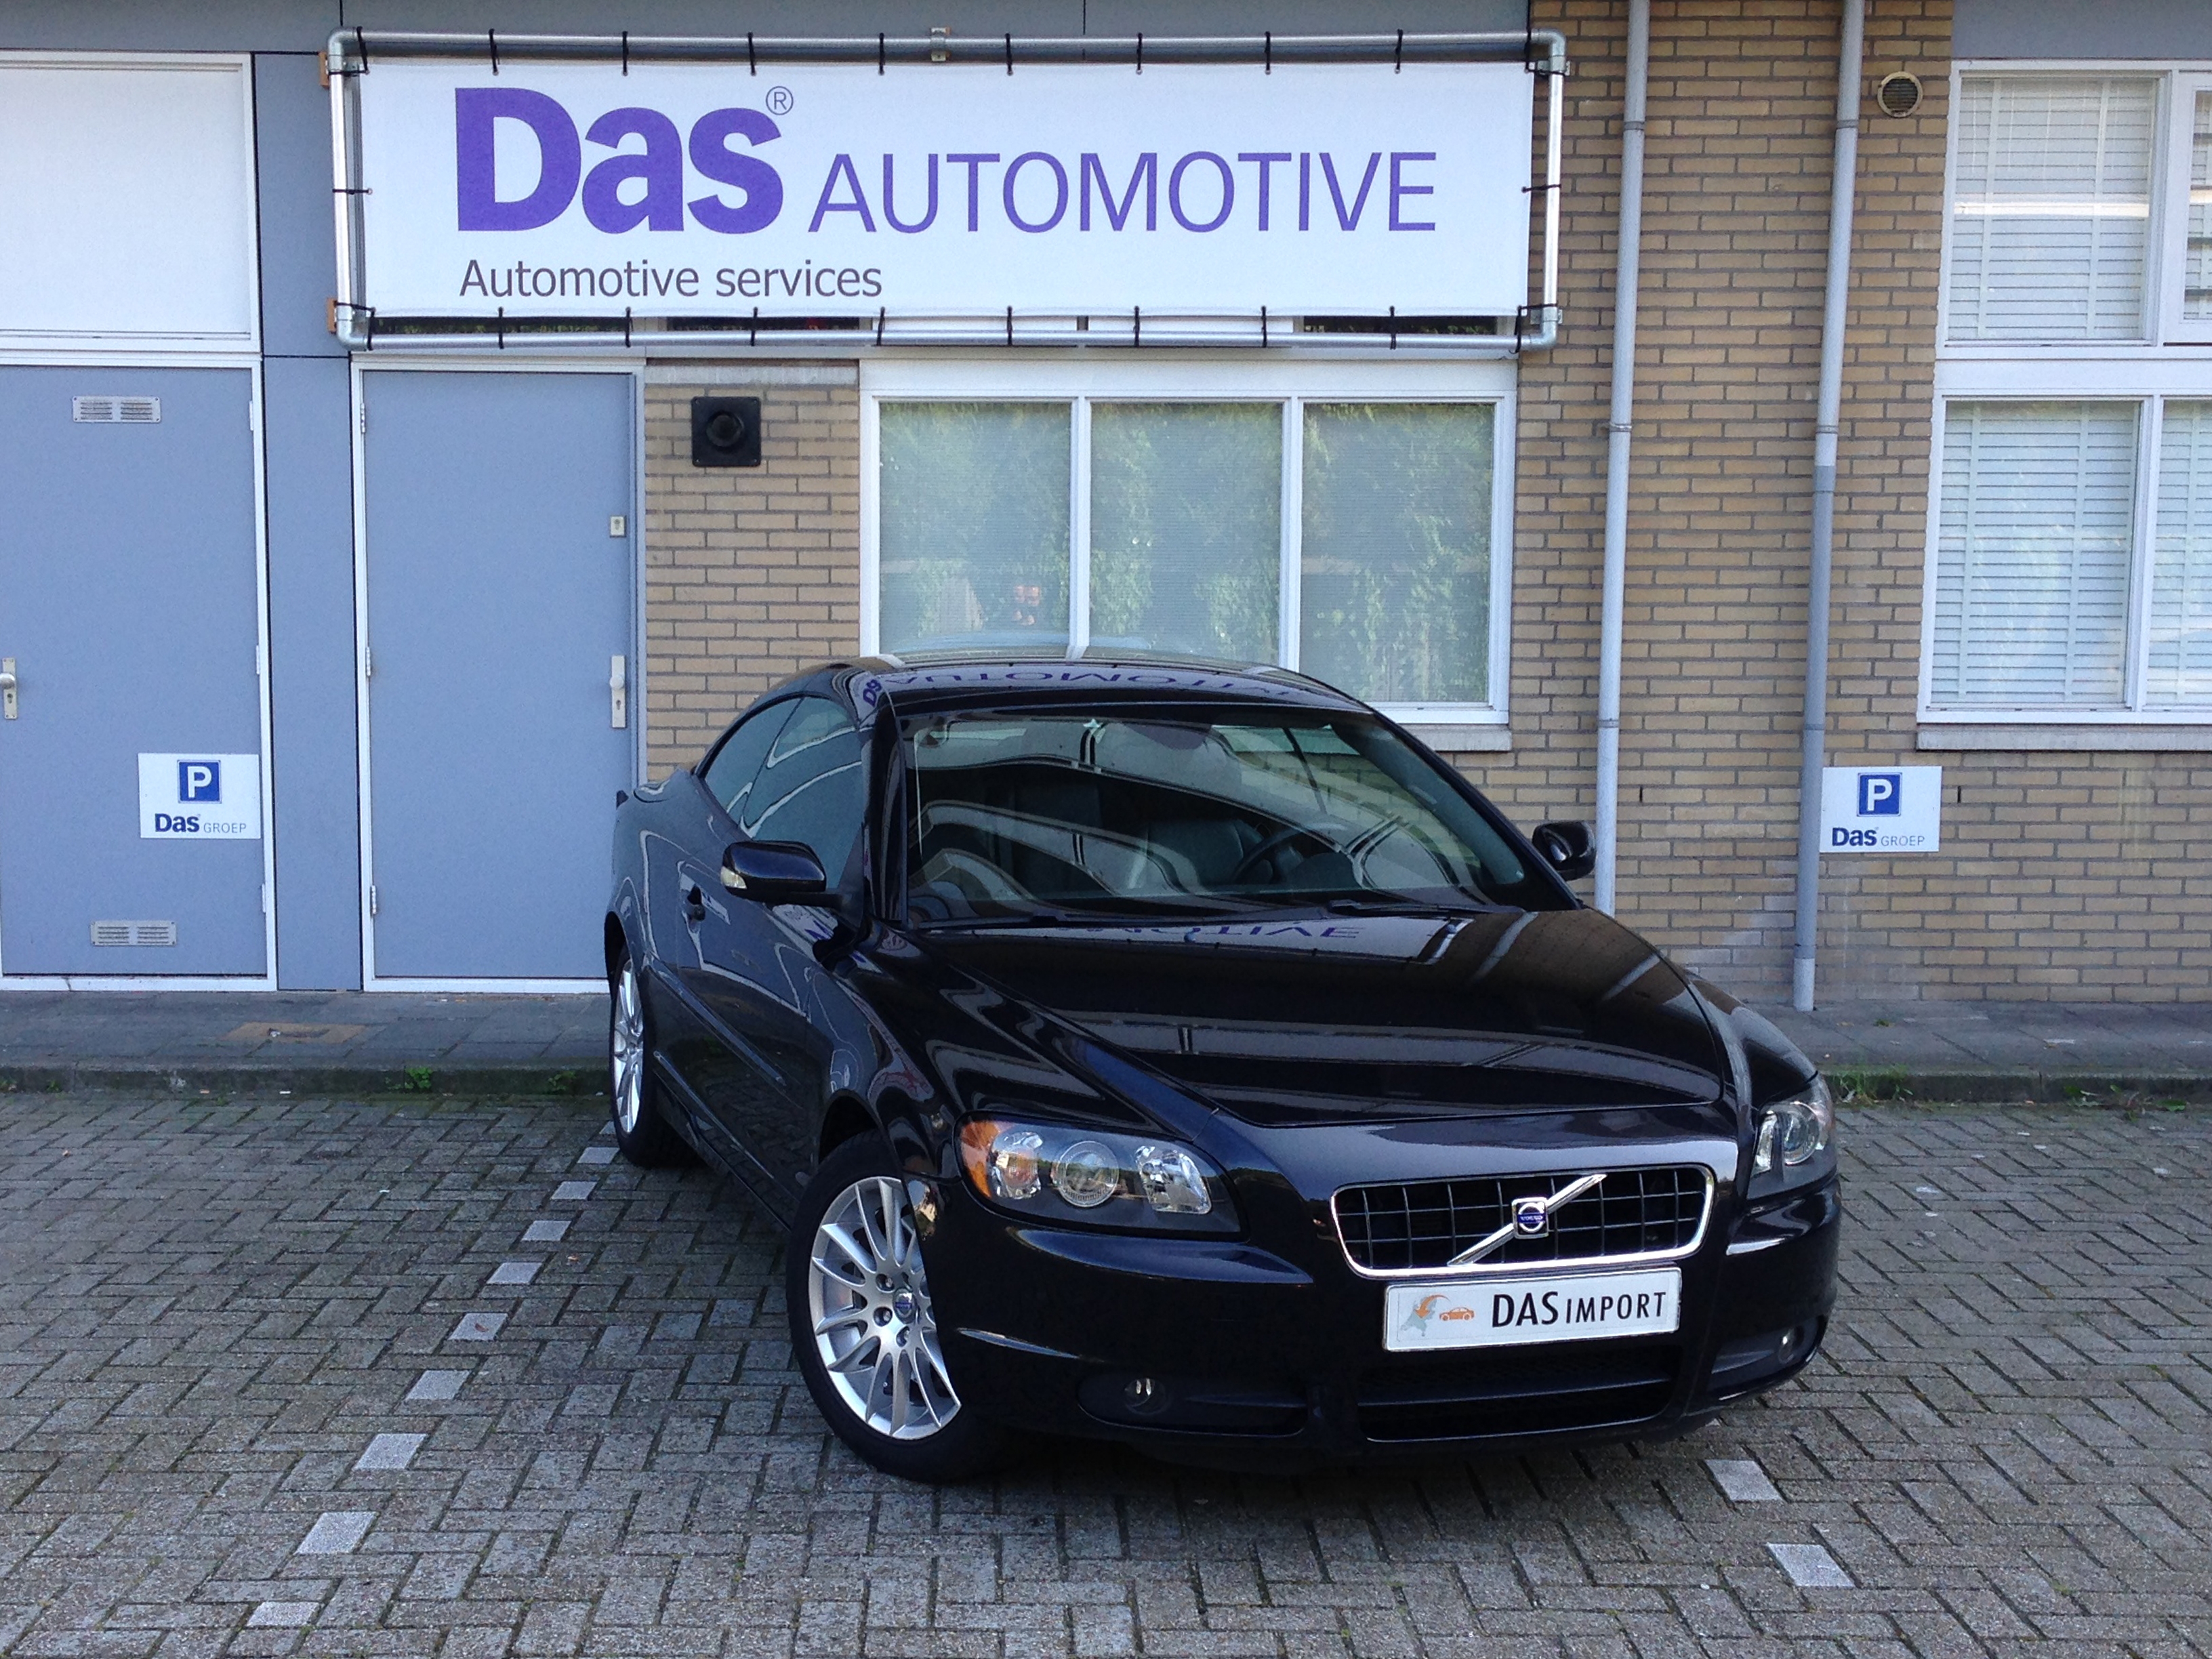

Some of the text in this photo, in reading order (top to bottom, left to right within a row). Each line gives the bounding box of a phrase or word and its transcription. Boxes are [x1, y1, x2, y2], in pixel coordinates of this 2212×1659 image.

[808, 150, 1437, 234] AUTOMOTIVE
[459, 260, 882, 297] Automotive services
[186, 765, 212, 798] P
[1866, 779, 1893, 812] P
[155, 813, 247, 834] Das GROEP
[1832, 827, 1925, 846] Das GROEP
